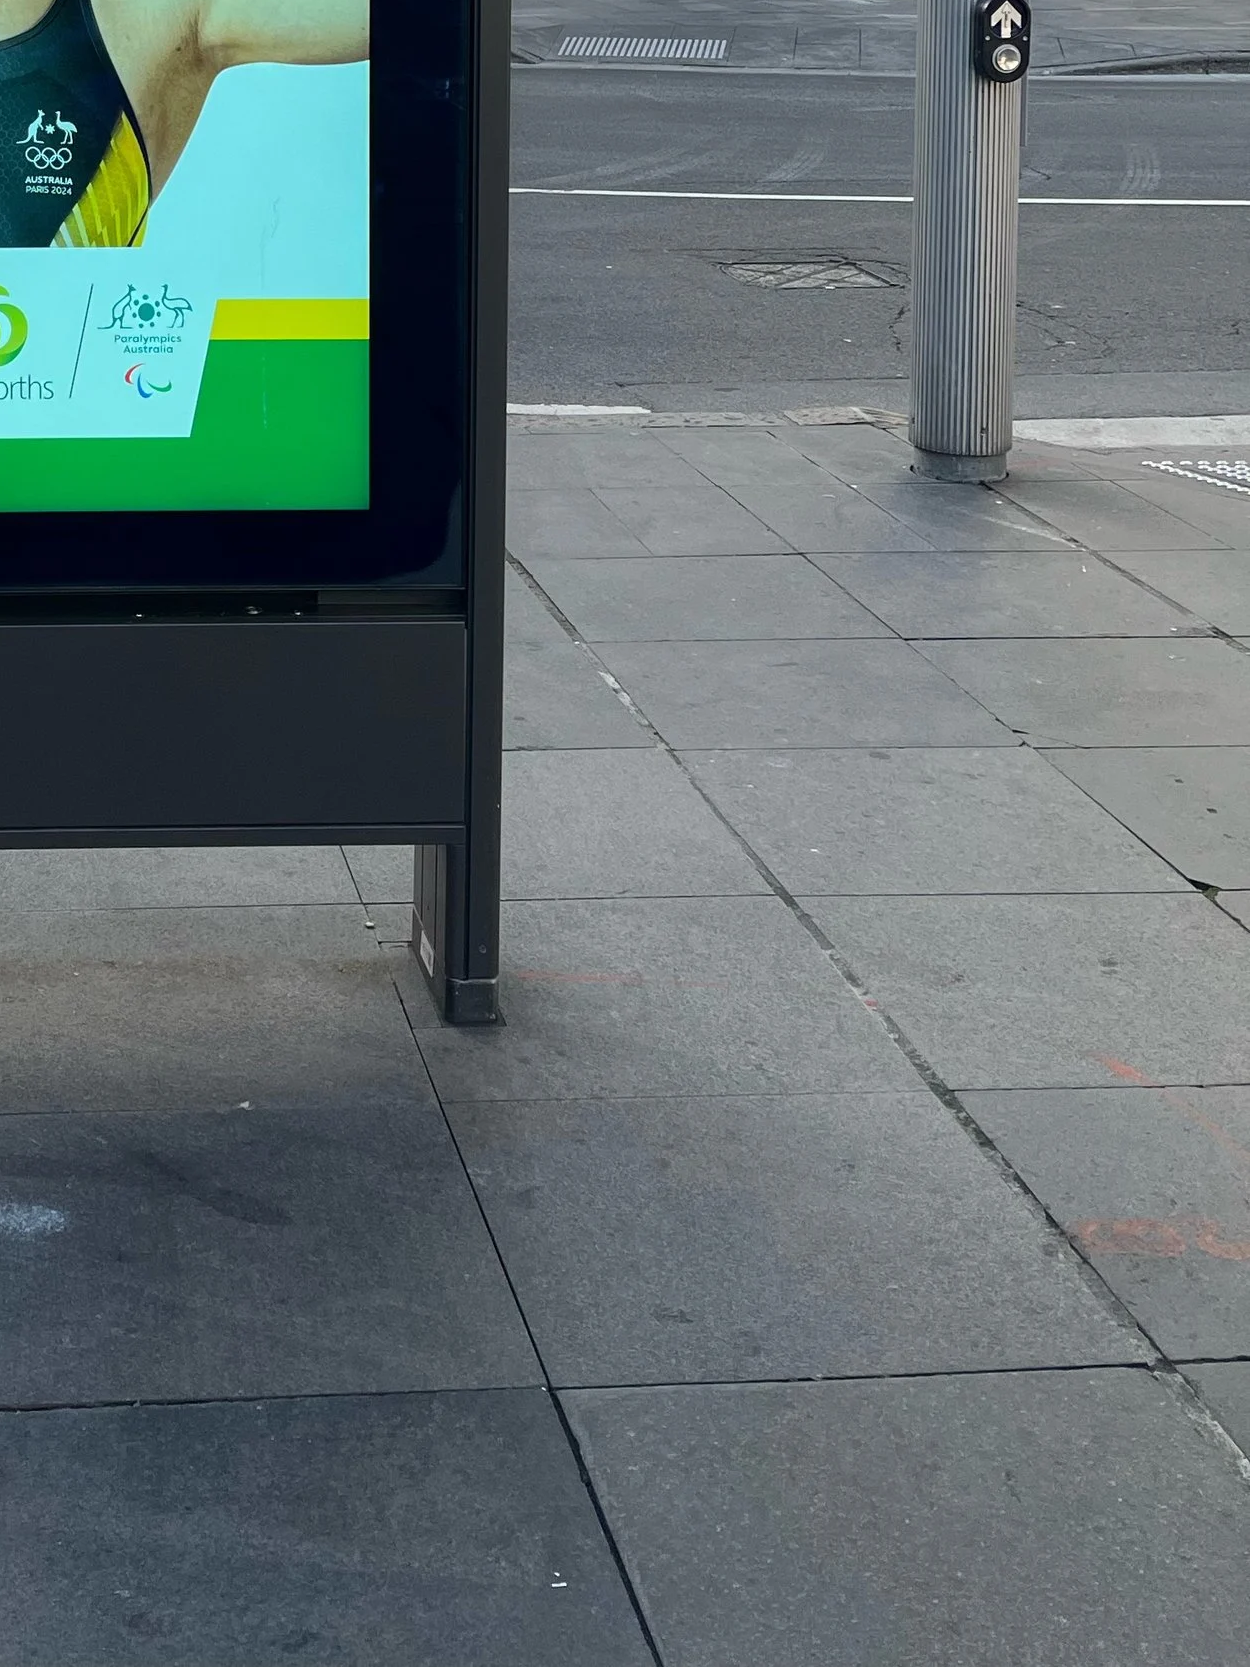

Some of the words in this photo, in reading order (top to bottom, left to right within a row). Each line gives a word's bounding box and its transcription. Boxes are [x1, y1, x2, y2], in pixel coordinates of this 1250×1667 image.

[24, 175, 74, 186] AUSTRALIA
[25, 185, 50, 194] PARIS
[50, 186, 73, 196] 2024
[114, 334, 182, 345] Paralympics
[123, 345, 174, 354] Australia
